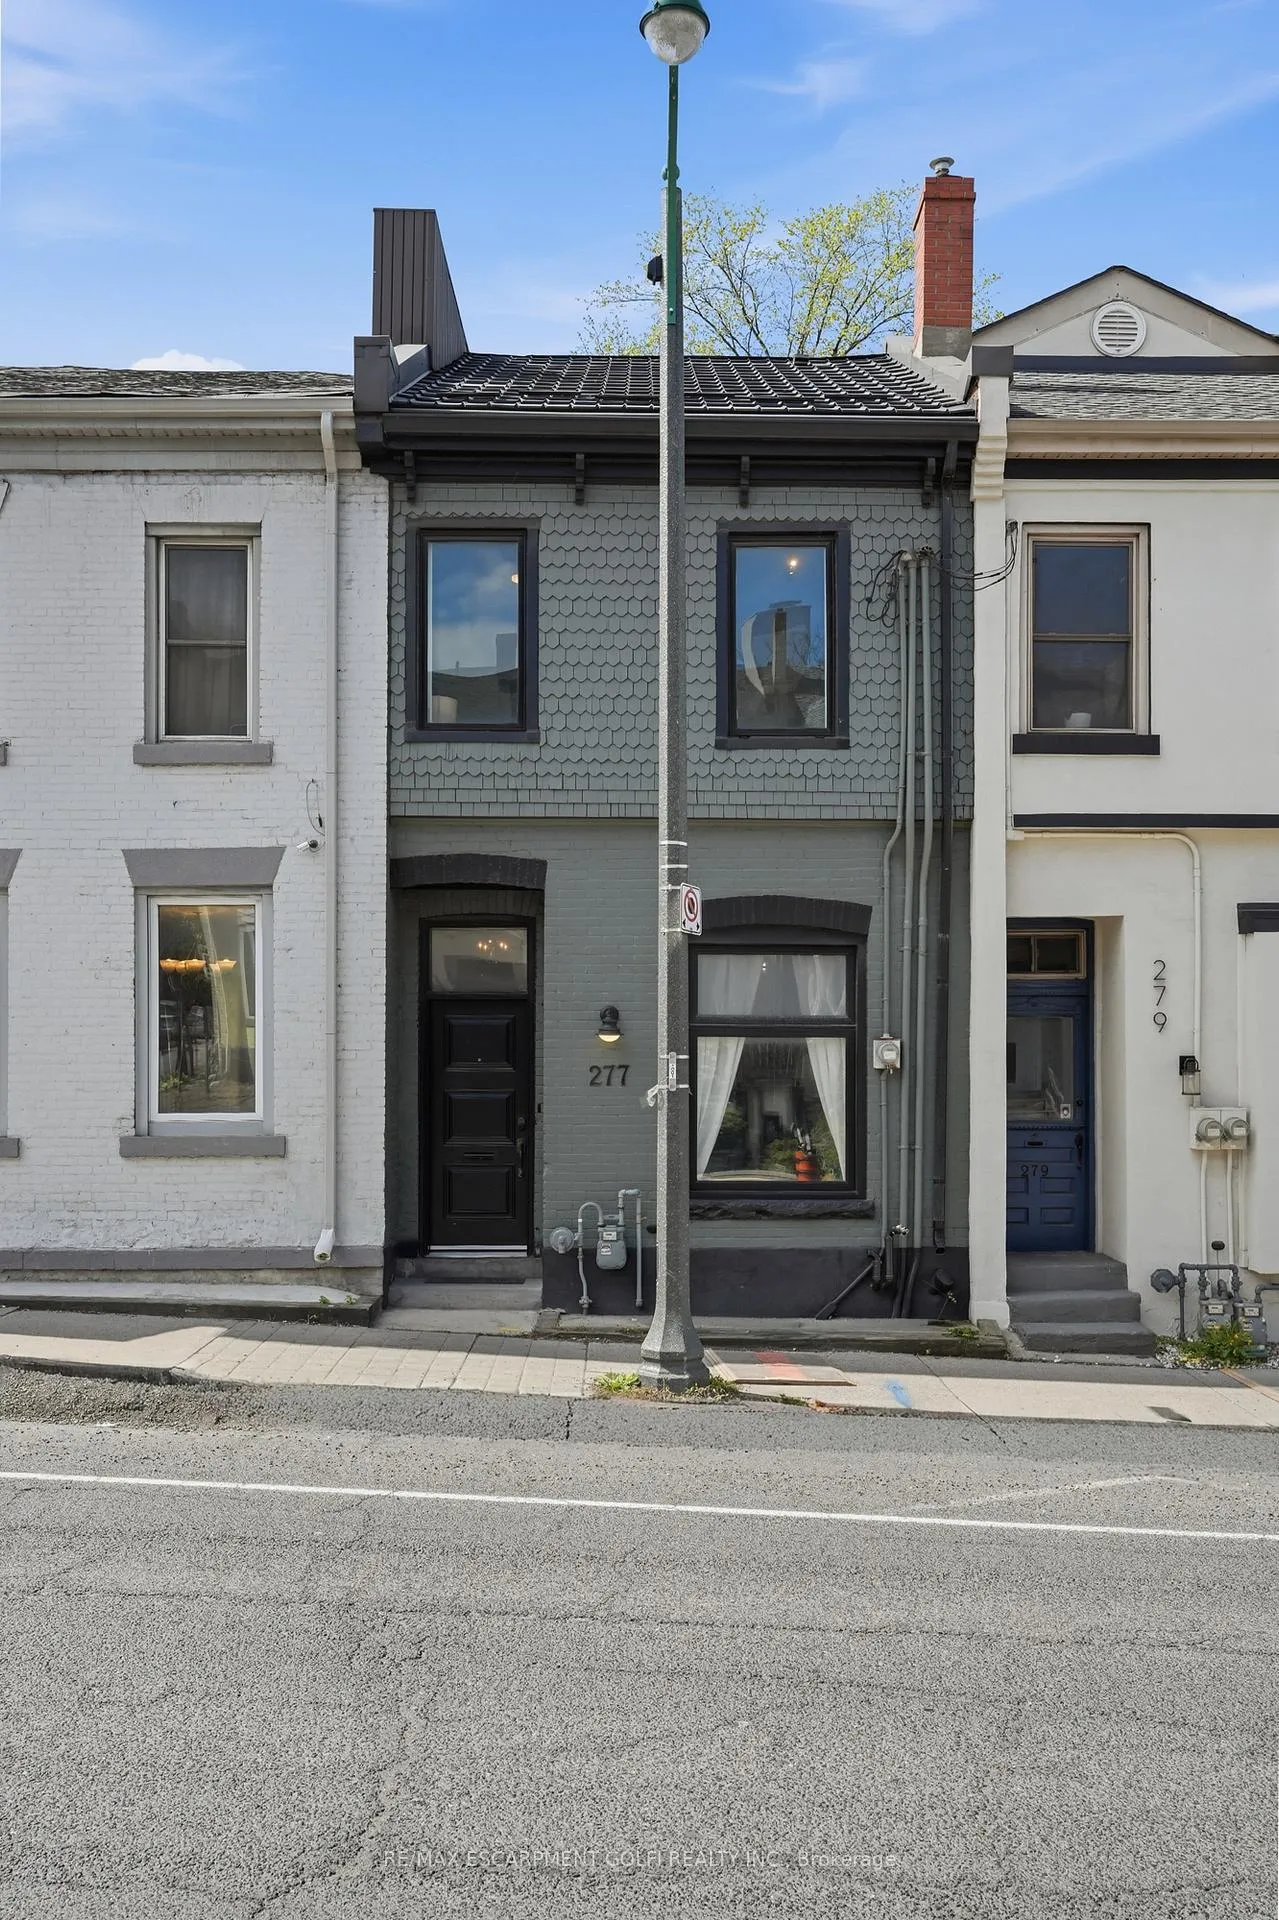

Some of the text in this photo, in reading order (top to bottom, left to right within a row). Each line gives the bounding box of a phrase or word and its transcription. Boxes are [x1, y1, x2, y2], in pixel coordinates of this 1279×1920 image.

[1153, 959, 1167, 1033] 279
[589, 1064, 630, 1087] 277
[1020, 1164, 1049, 1177] 279
